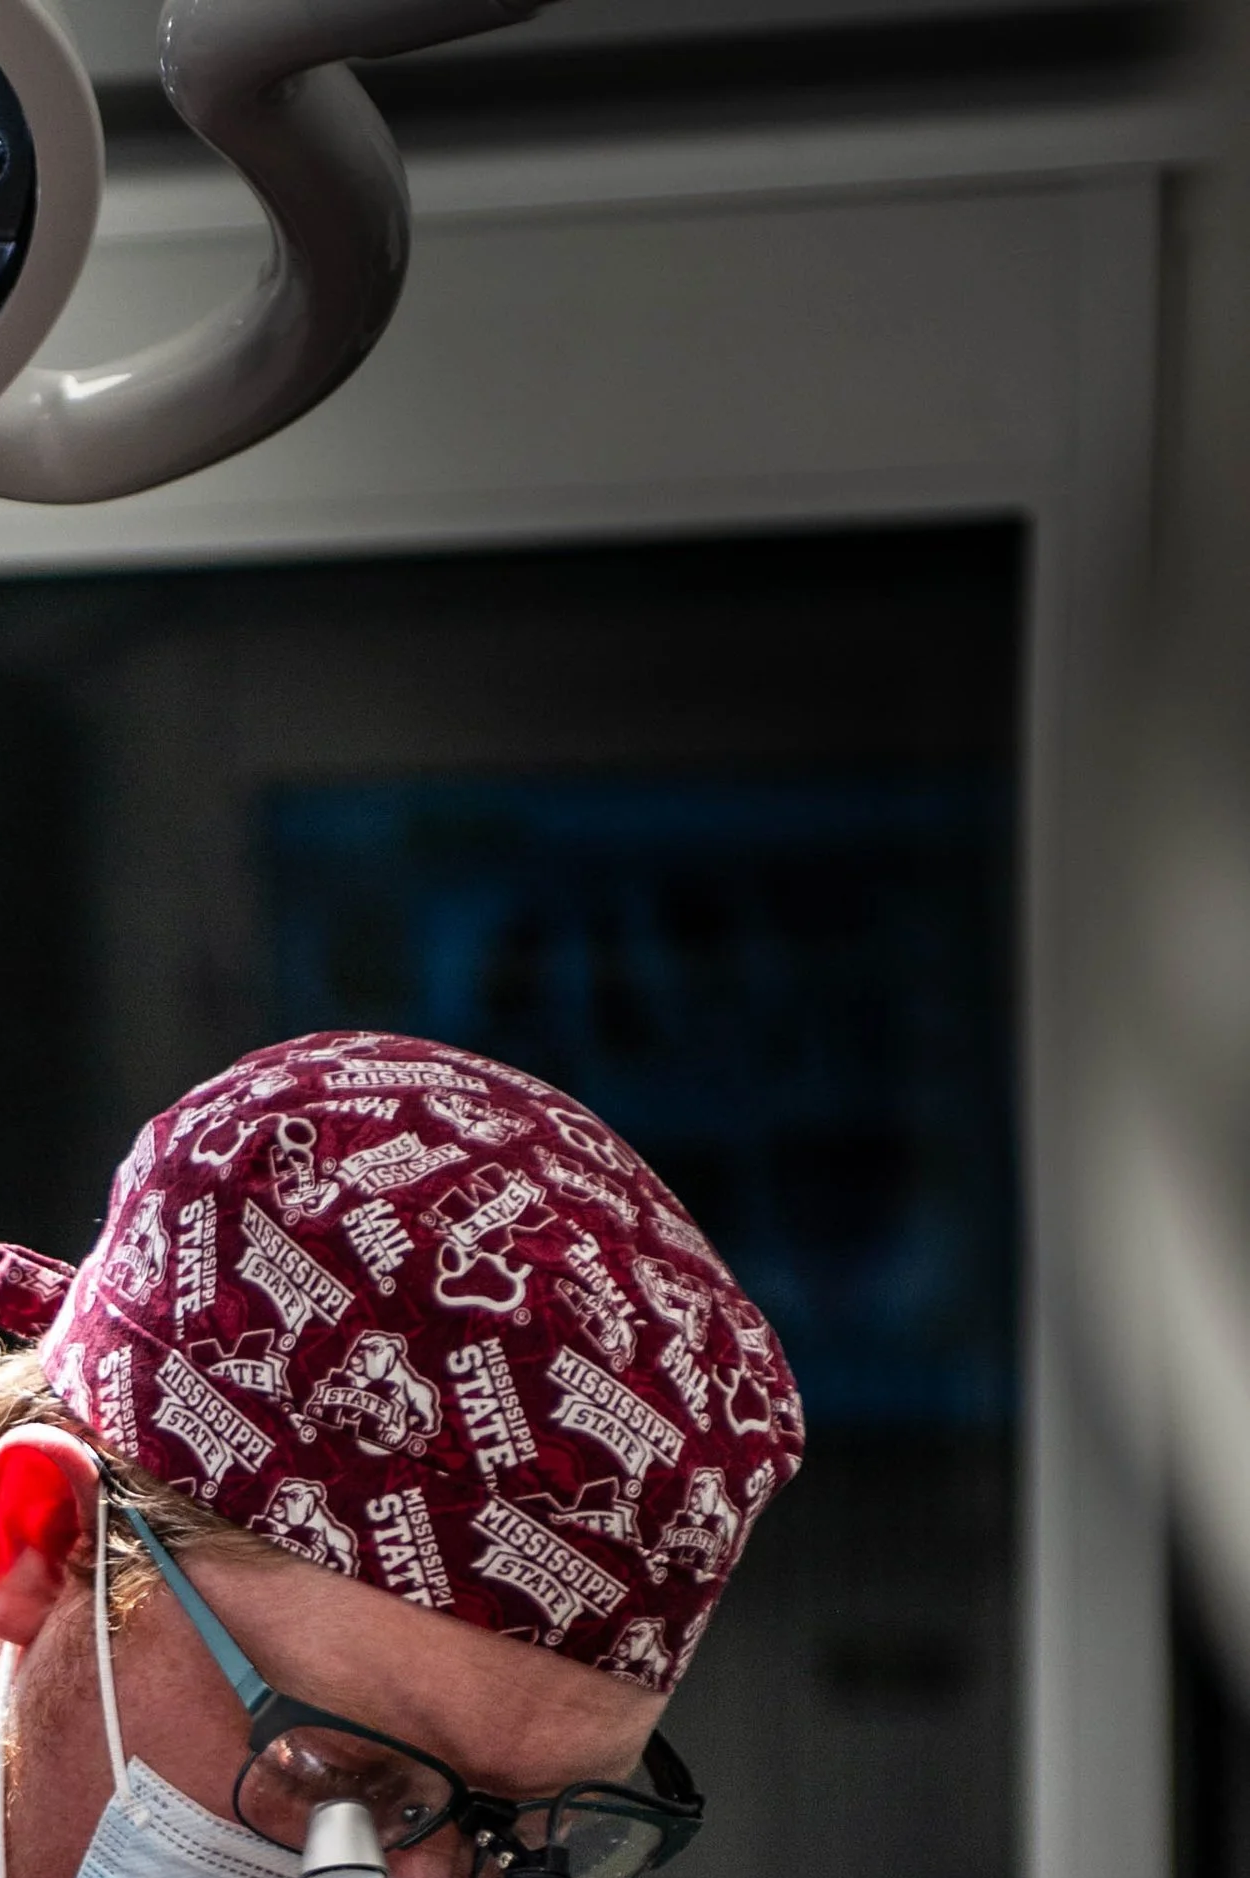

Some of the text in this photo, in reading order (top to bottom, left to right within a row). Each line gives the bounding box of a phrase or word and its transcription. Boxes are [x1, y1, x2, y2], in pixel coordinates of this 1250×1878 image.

[357, 1138, 412, 1165] STATE
[360, 1143, 466, 1195] MISSISSI
[202, 1192, 217, 1309] MISSISSIPPI
[343, 1207, 393, 1282] STATE
[363, 1198, 415, 1267] HAIL
[461, 1188, 524, 1239] STATE
[175, 1199, 204, 1321] STATE
[244, 1205, 351, 1319] MISSISSIPPI
[252, 1260, 300, 1317] STATE
[99, 1350, 127, 1452] STAT
[158, 1354, 273, 1469] MISSISSIPPI
[168, 1410, 220, 1465] STATE
[328, 1389, 389, 1418] STATE
[447, 1344, 519, 1475] STATE
[482, 1337, 538, 1463] MISSISSIPPI
[551, 1352, 684, 1462] MISSISSIPPI
[574, 1407, 640, 1463] STATE
[402, 1486, 456, 1607] MISSISSIPPI
[476, 1501, 627, 1613] MISSISSIPPI
[497, 1559, 567, 1616] STATE
